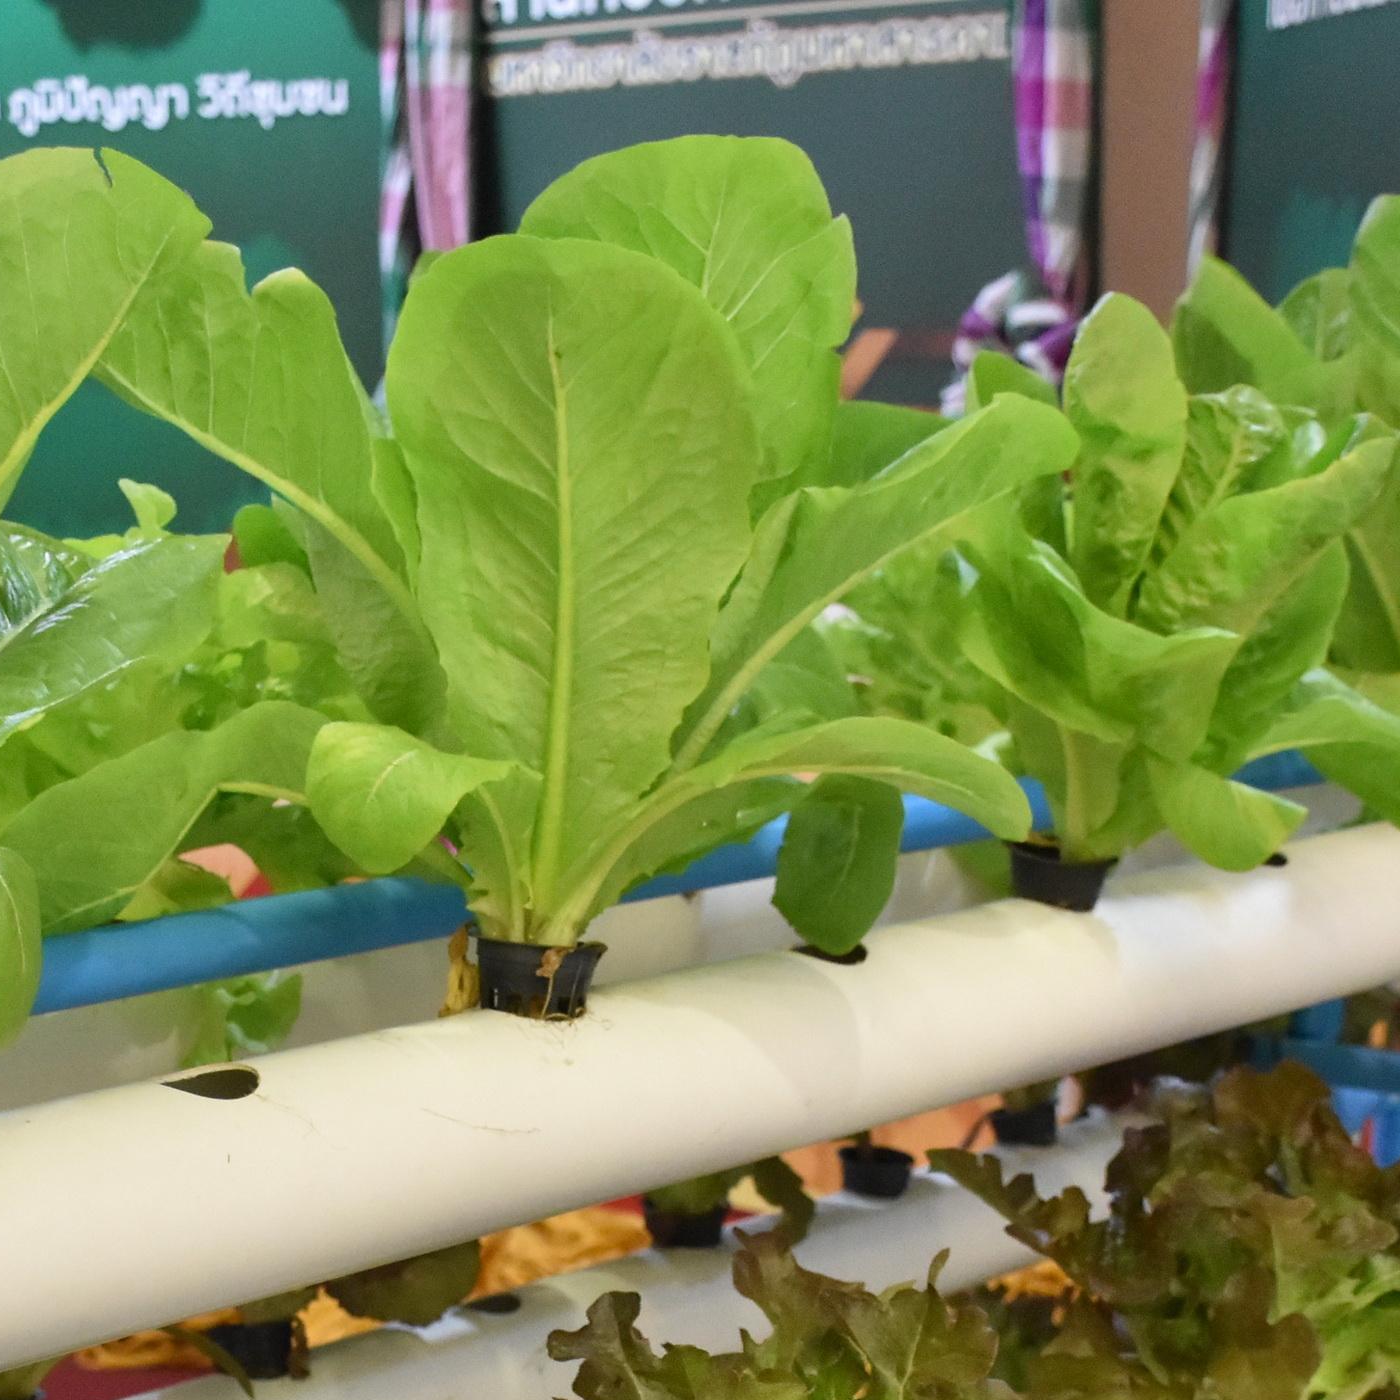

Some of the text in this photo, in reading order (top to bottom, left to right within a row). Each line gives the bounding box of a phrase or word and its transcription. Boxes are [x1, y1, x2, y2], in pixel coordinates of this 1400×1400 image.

[8, 74, 190, 137] ภูมิปัญญา
[196, 69, 349, 130] วิถีชุมชน
